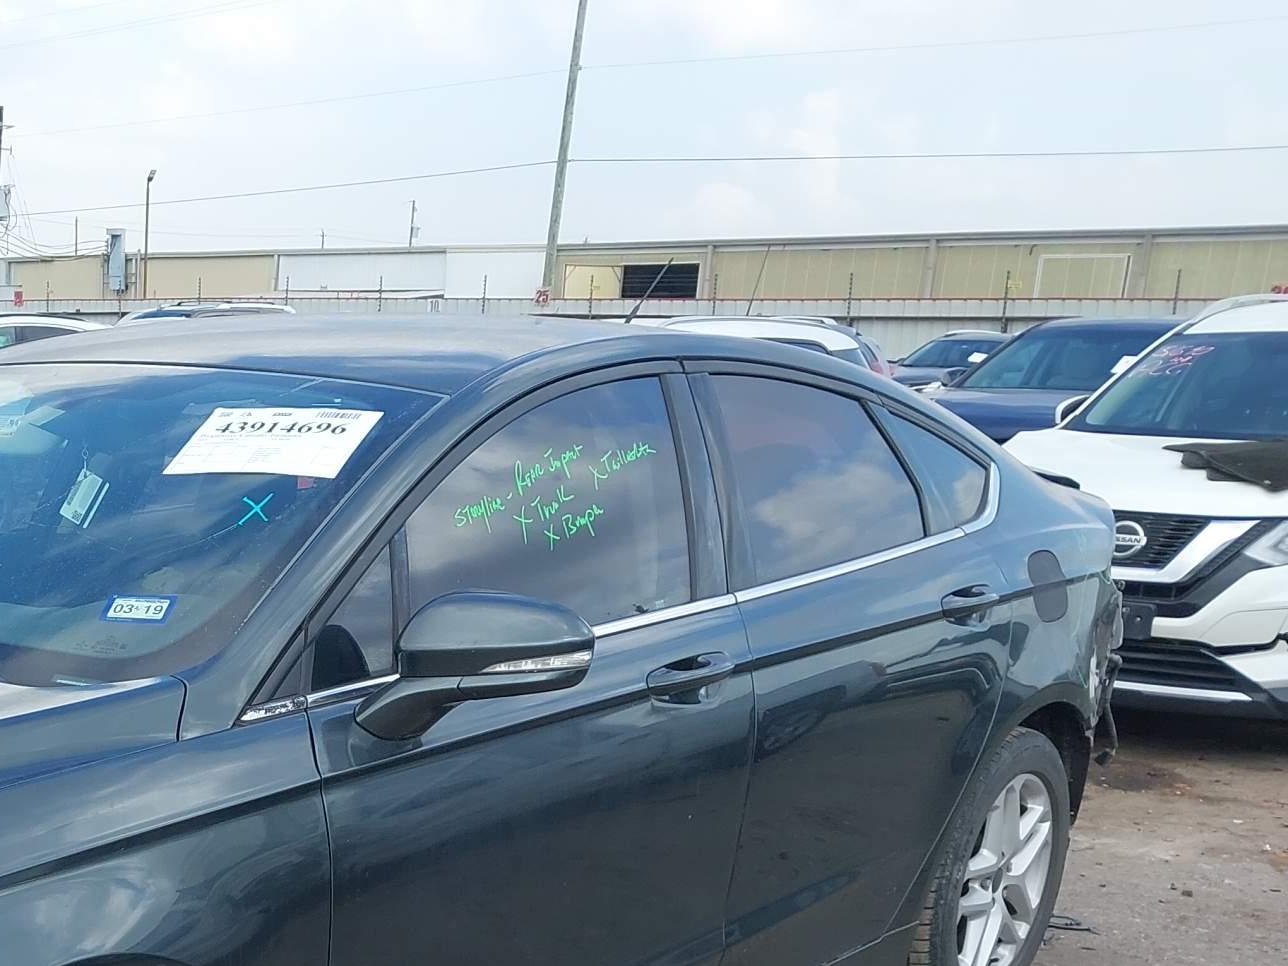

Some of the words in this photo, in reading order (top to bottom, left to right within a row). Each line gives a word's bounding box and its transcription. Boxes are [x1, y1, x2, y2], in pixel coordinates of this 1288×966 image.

[534, 289, 550, 304] 25
[215, 420, 349, 436] 43914696
[113, 603, 134, 614] 03
[144, 604, 164, 615] 19
